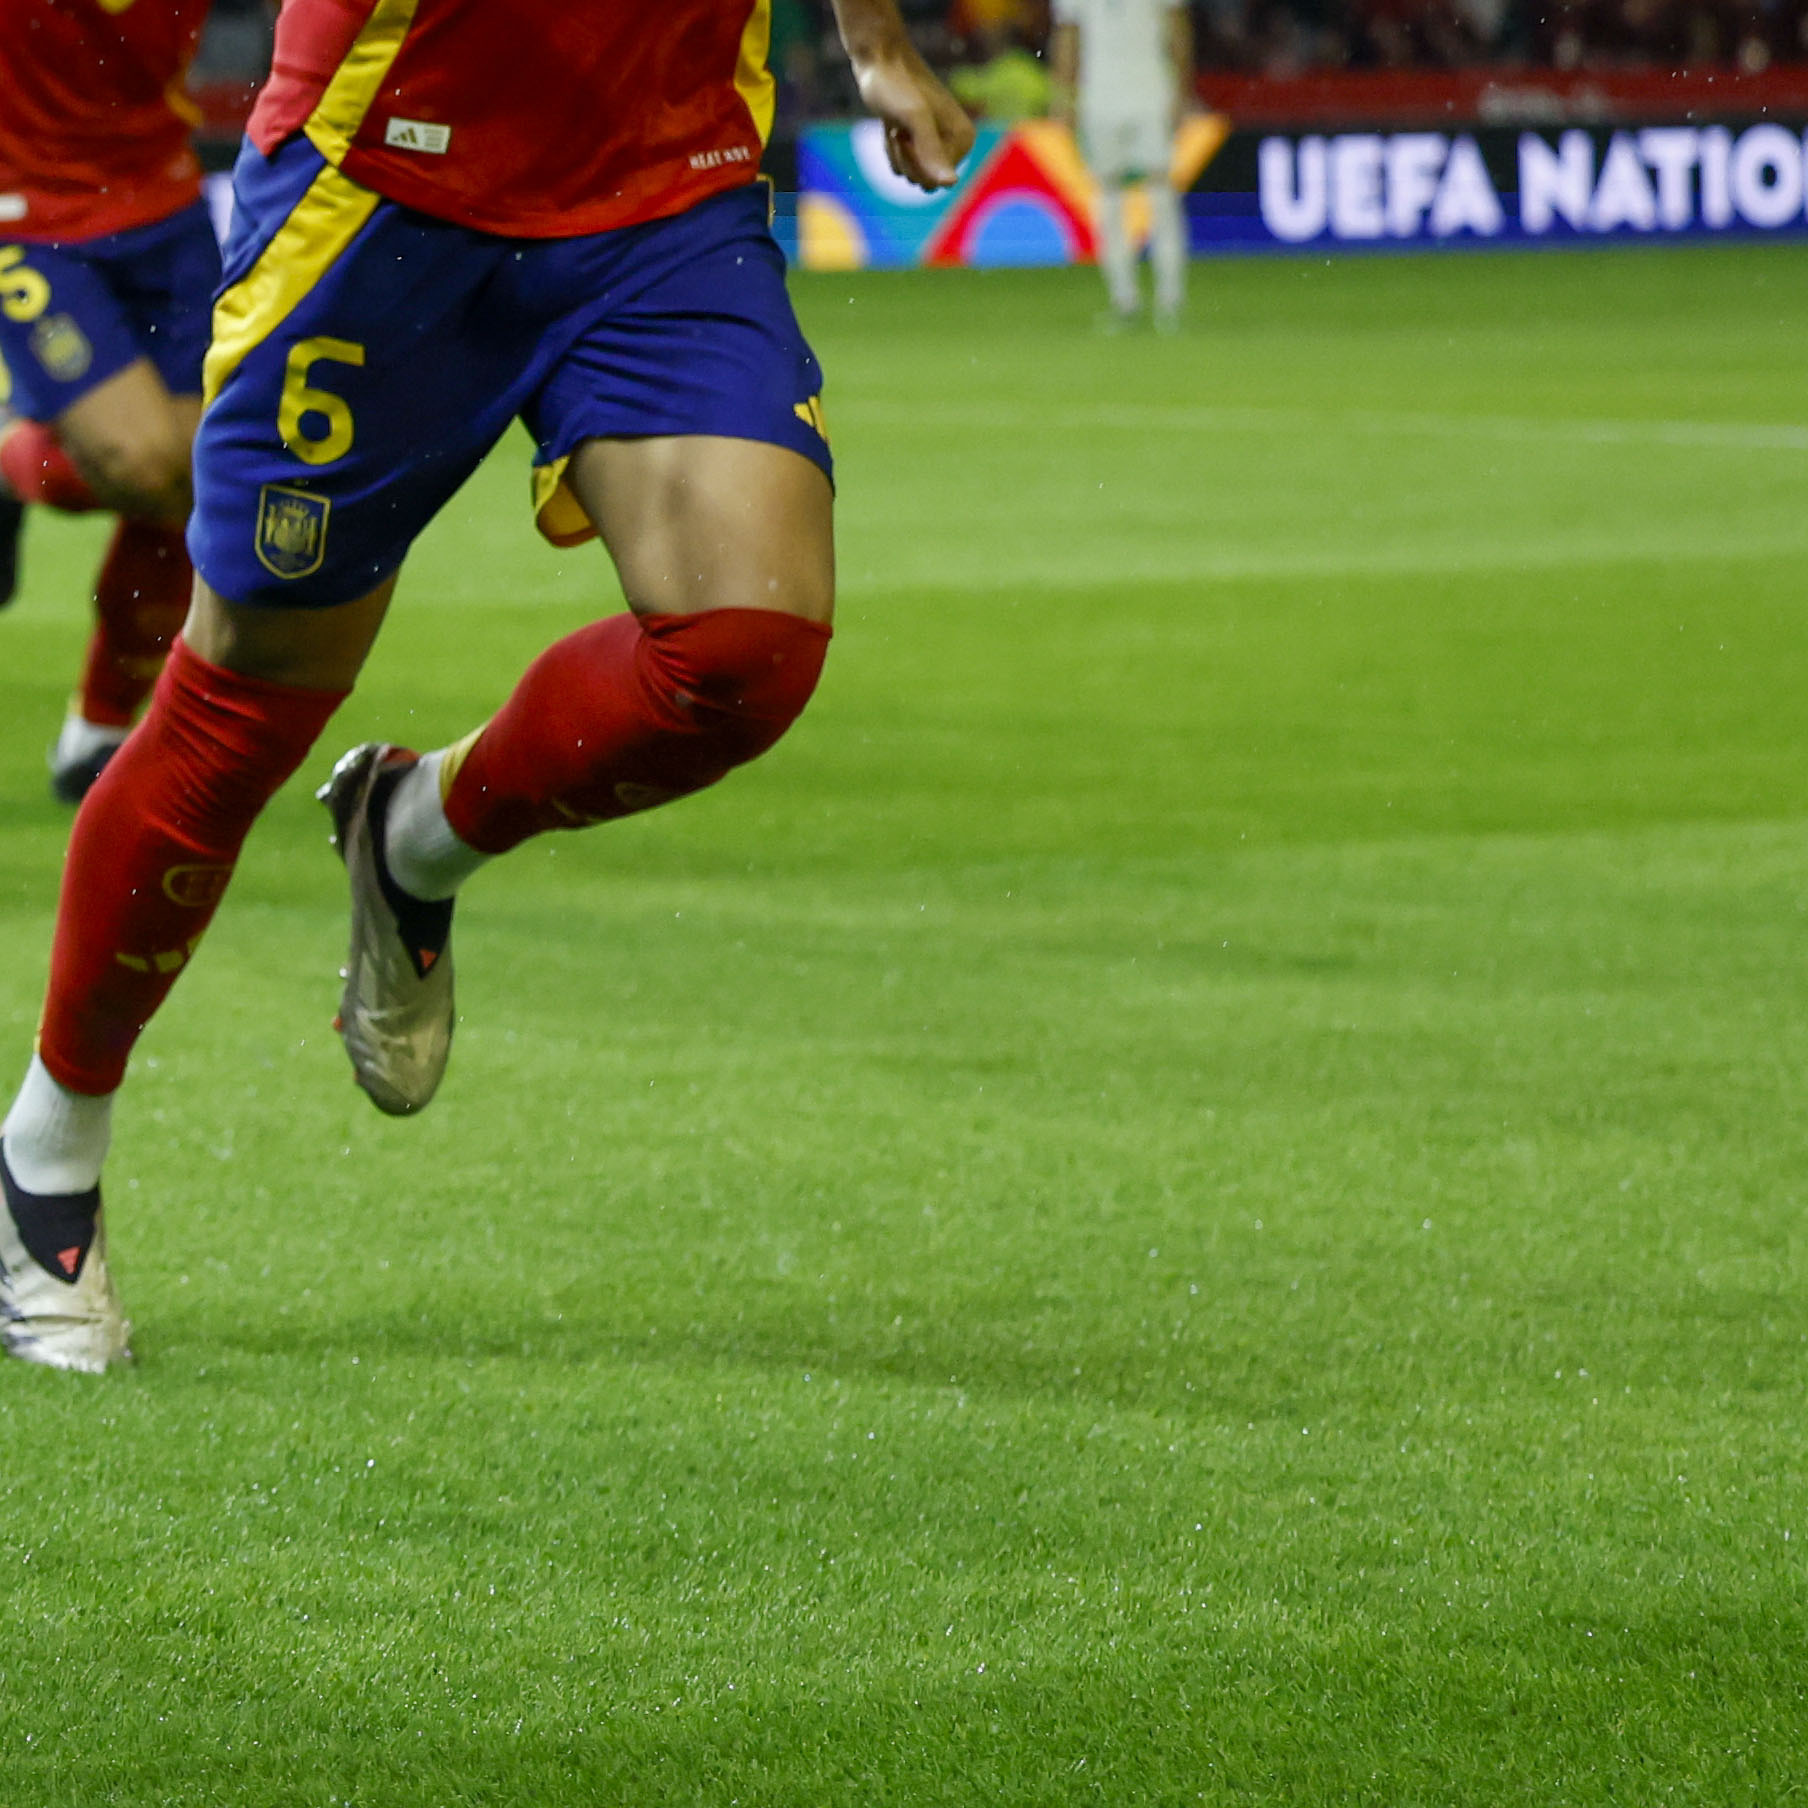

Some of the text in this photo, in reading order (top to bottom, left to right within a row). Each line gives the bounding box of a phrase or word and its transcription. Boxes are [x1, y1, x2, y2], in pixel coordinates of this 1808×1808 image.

[1257, 122, 1808, 242] UEFA NATIO
[276, 334, 367, 466] 6
